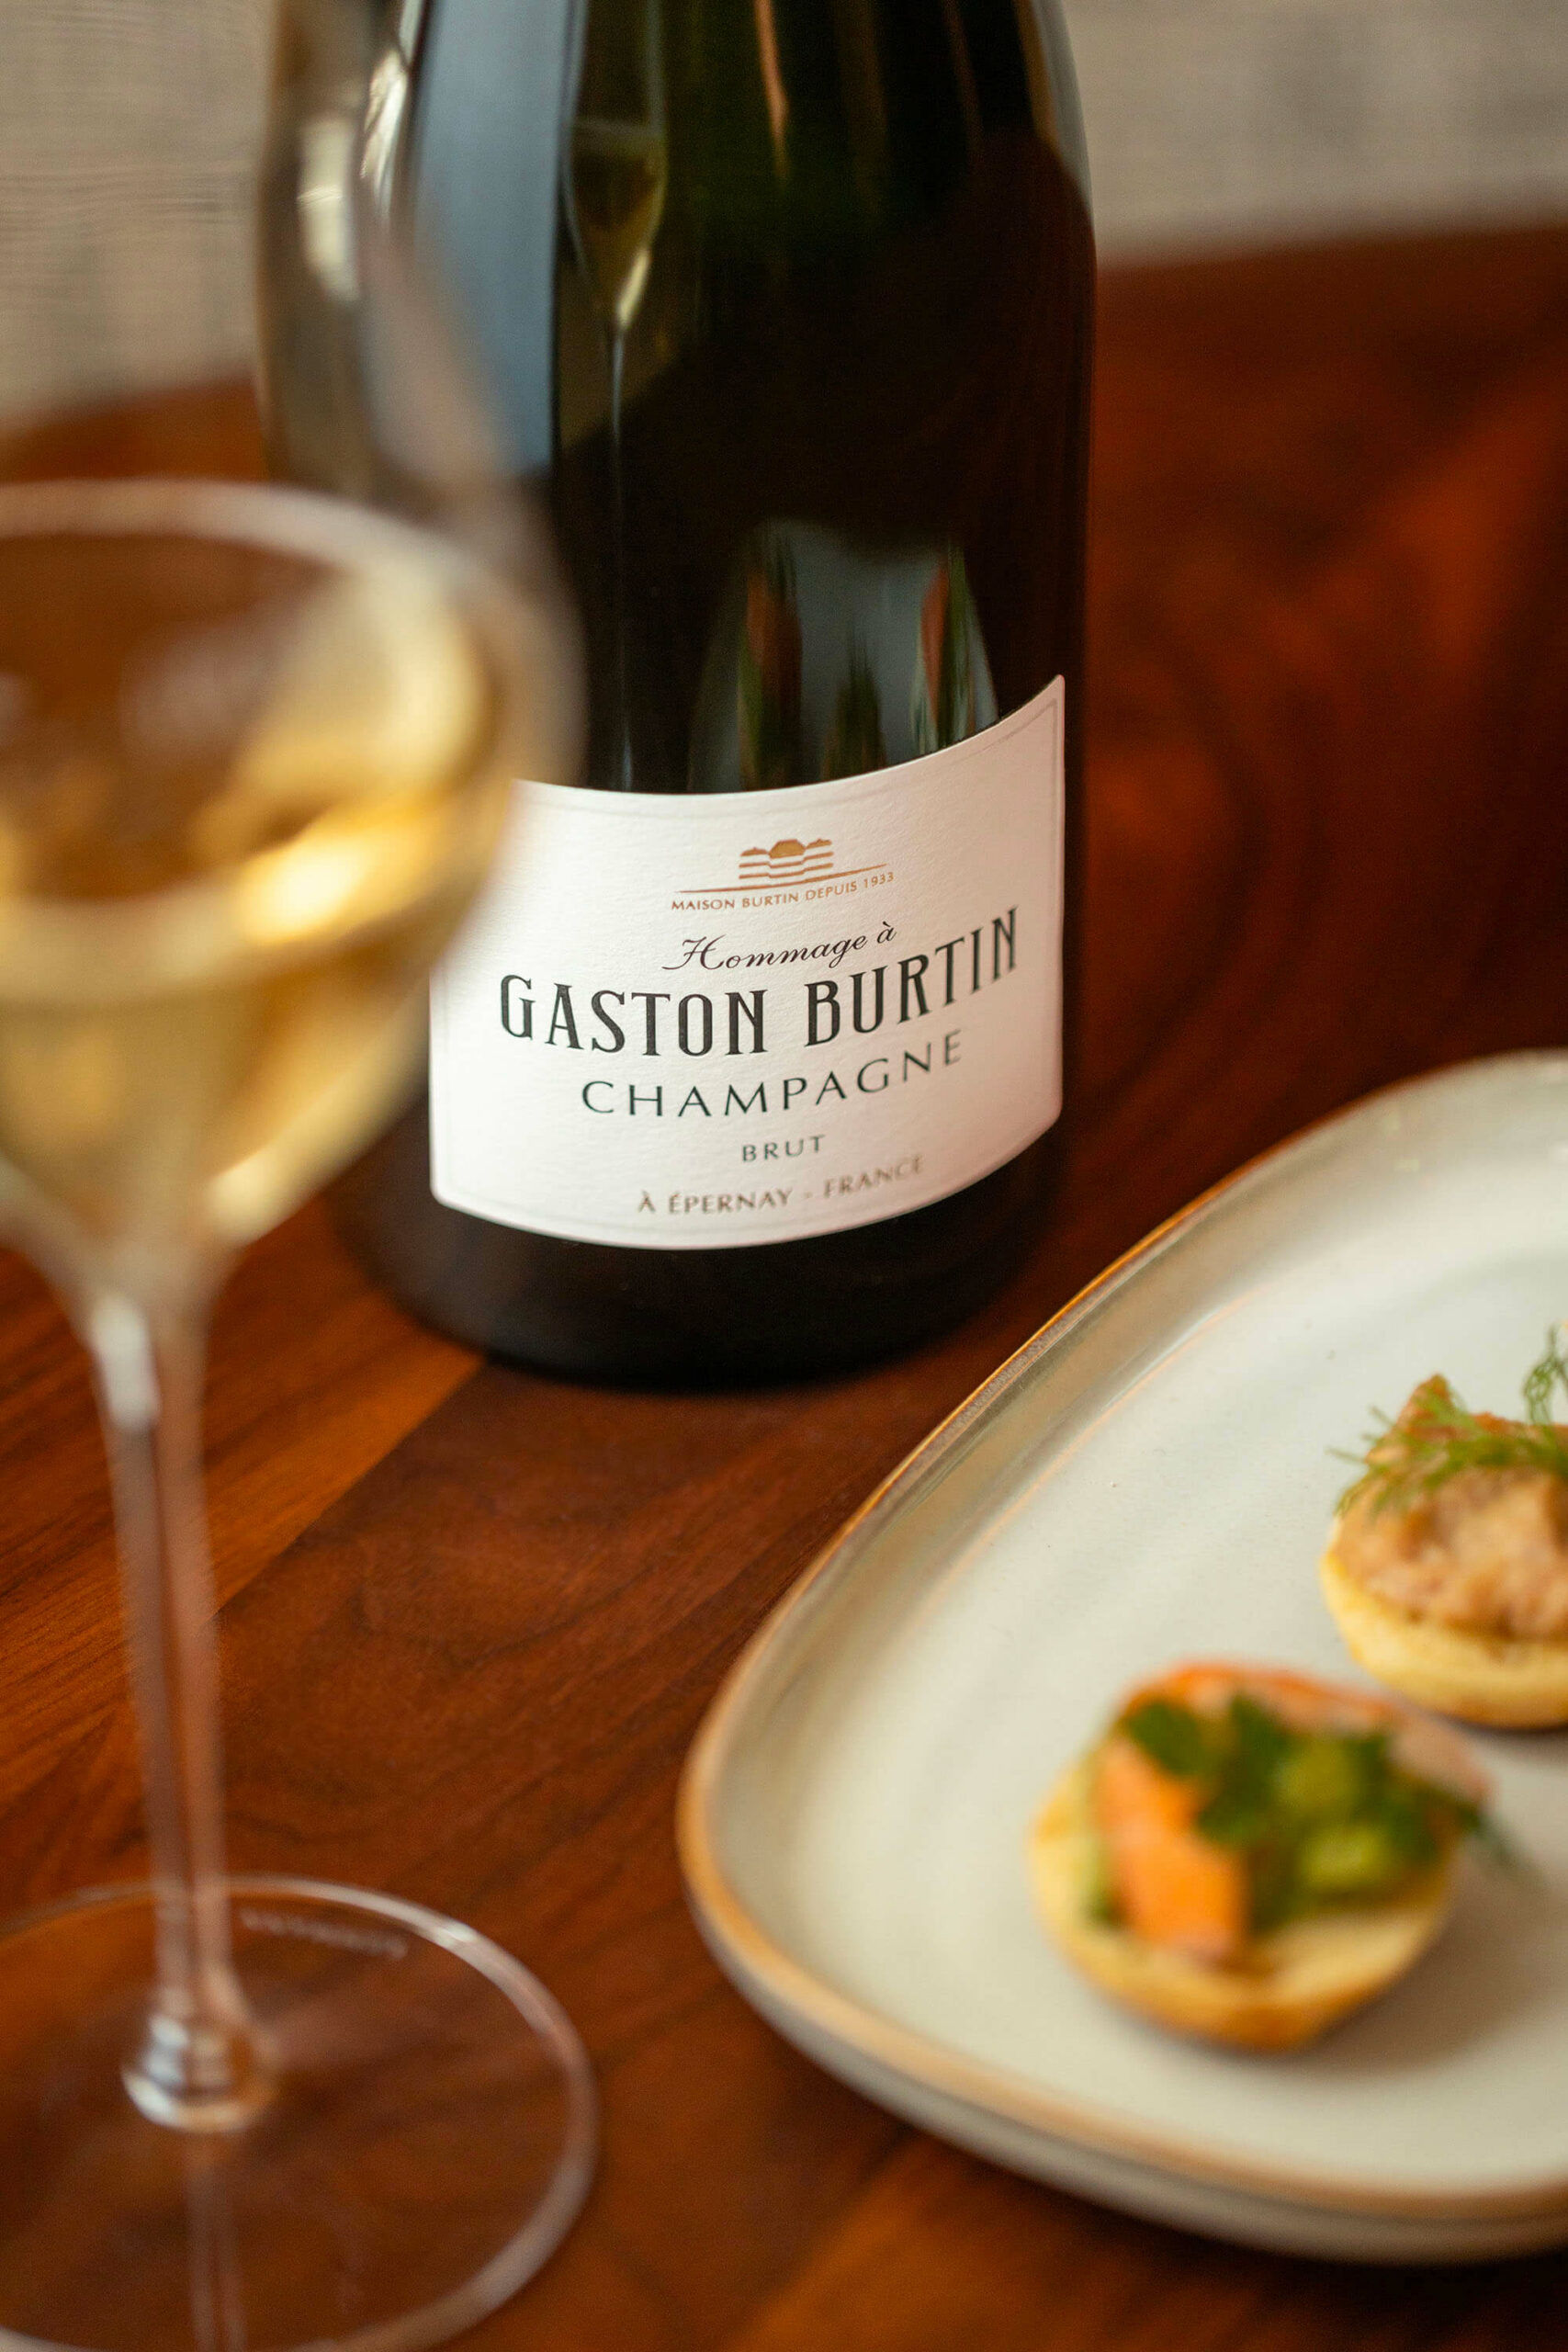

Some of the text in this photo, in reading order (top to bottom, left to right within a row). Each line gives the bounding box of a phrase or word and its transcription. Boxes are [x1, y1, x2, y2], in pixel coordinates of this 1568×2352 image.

[671, 872, 895, 910] MAISON BURTIN DEPUIS 1933
[661, 921, 897, 970] Hommage à
[500, 905, 1020, 1057] GASTON BURTIN
[581, 1029, 963, 1118] CHAMPAGNE
[742, 1135, 825, 1162] BRUT
[638, 1191, 656, 1213] À
[668, 1189, 793, 1215] ÉPERNAY
[823, 1154, 924, 1198] FRANCE
